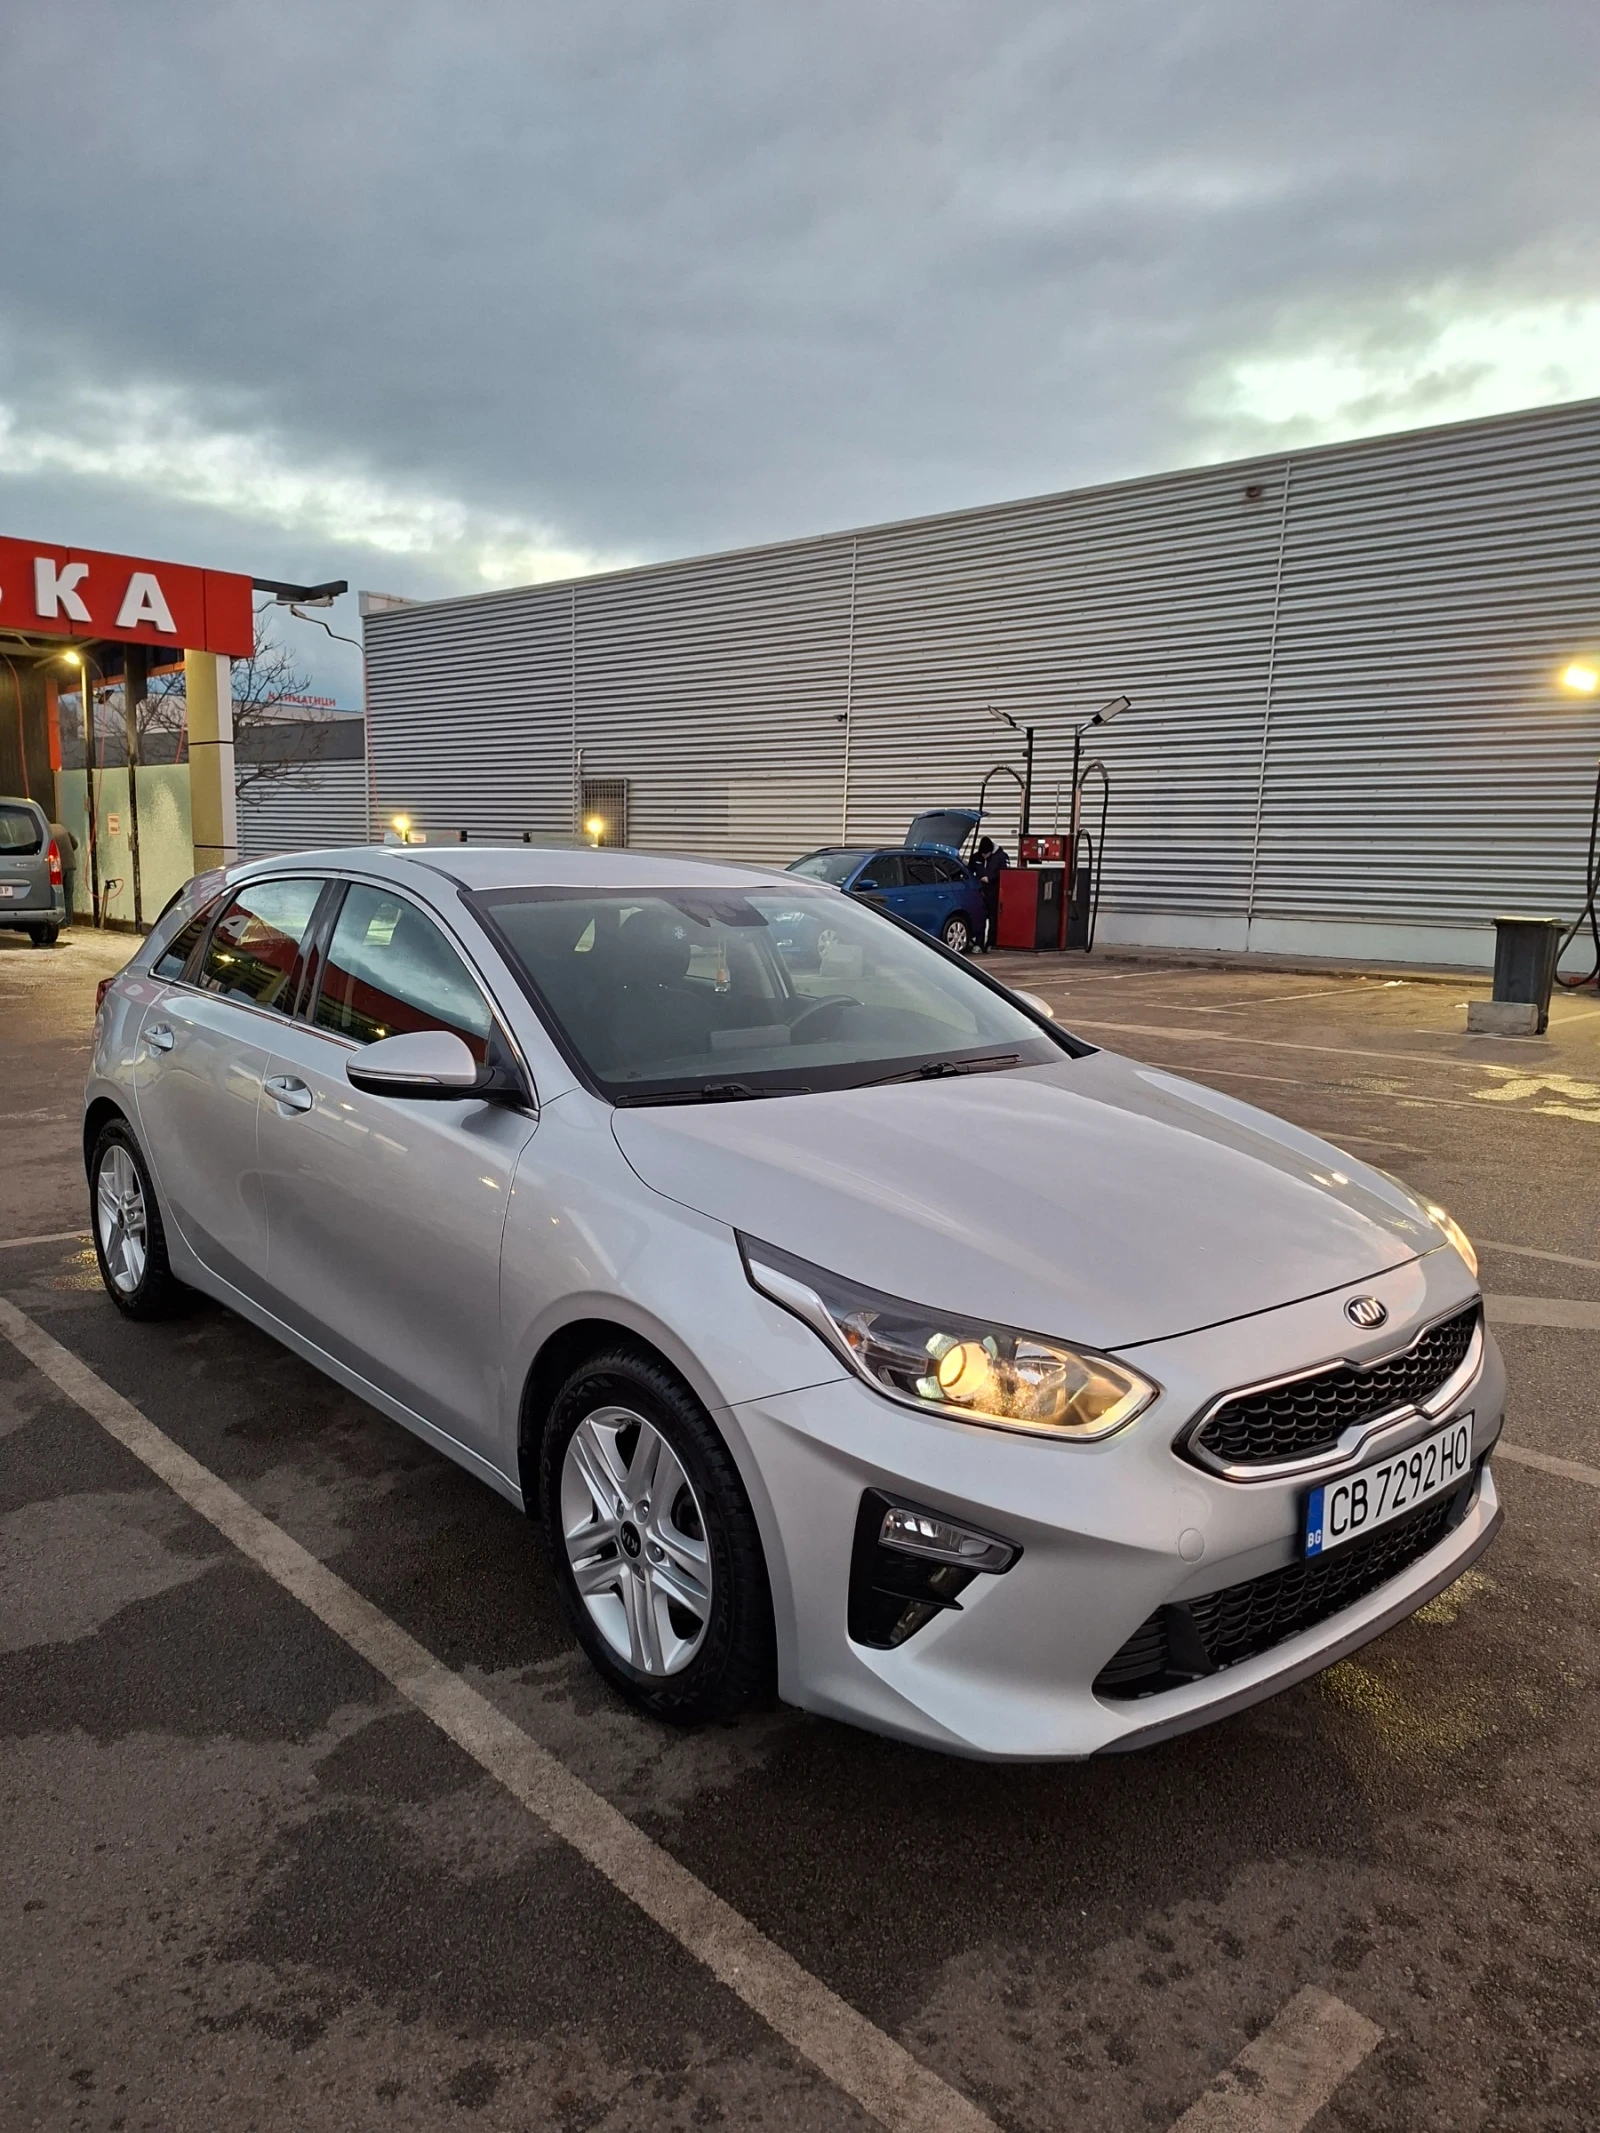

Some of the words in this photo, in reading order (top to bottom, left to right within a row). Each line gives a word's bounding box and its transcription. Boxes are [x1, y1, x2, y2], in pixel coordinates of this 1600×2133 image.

[0, 556, 178, 634] КА
[268, 691, 336, 706] КИМАТИЦИ
[1350, 1297, 1386, 1324] KIA
[1329, 1478, 1369, 1537] CB
[1375, 1446, 1437, 1519] 7292
[1440, 1425, 1469, 1482] HO
[621, 1527, 638, 1553] KIA
[1307, 1532, 1322, 1548] BG
